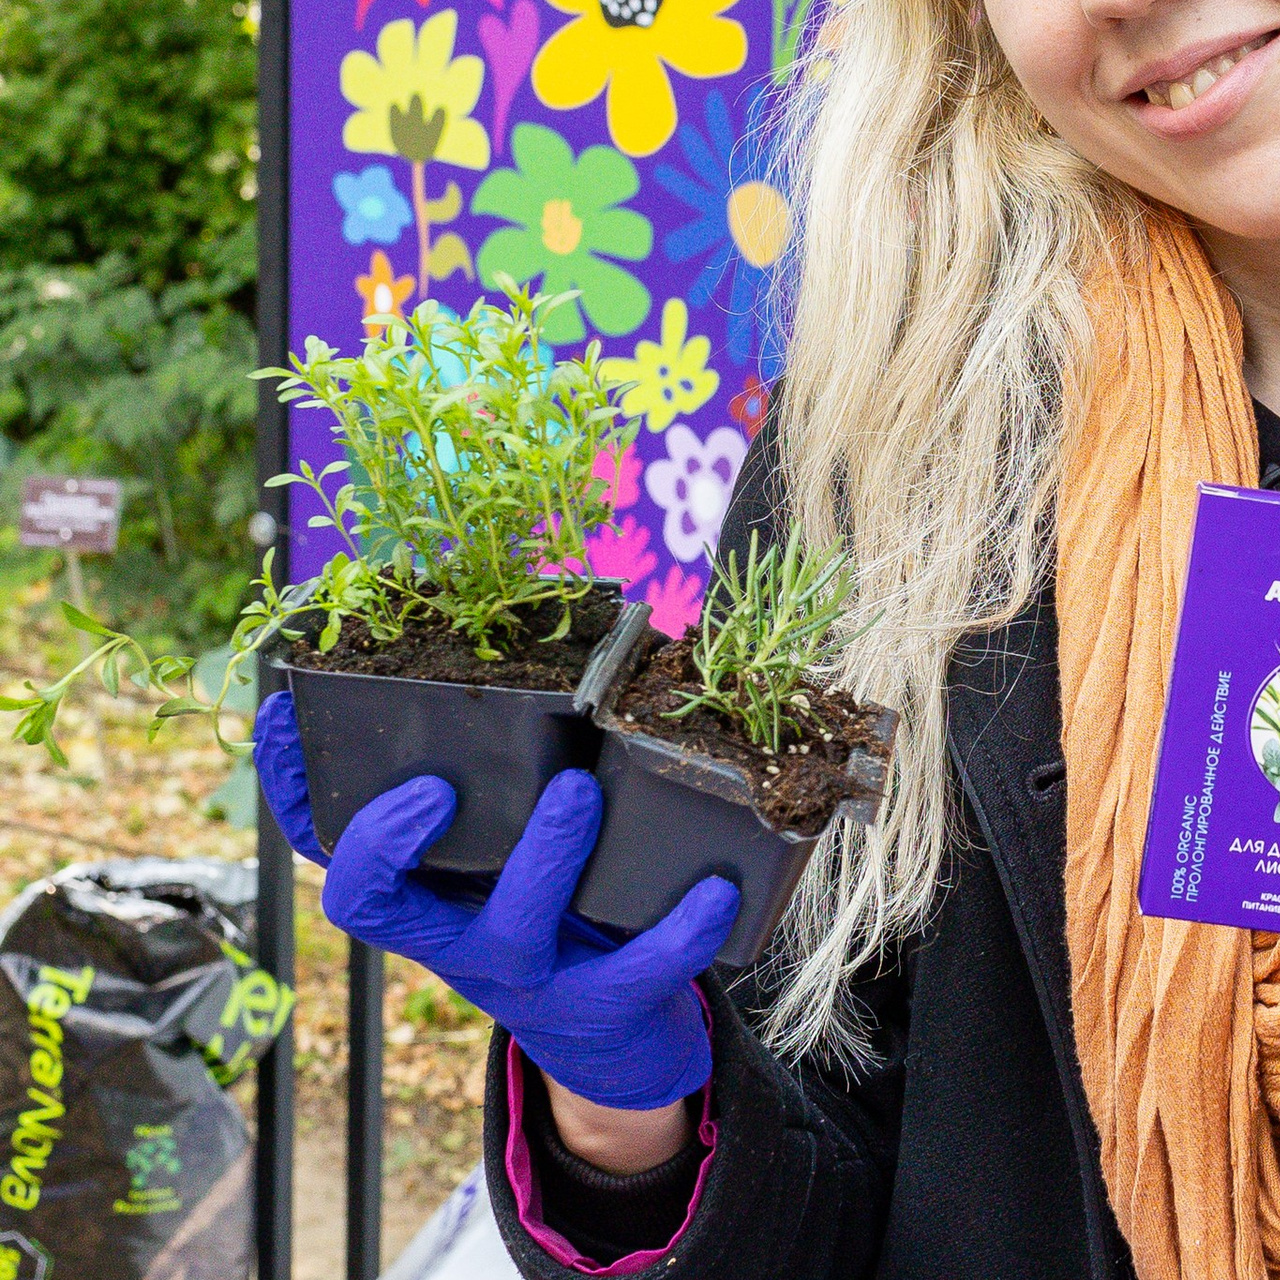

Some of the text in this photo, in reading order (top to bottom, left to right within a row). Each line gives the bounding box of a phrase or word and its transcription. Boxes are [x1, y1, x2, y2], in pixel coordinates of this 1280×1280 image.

[1171, 794, 1197, 899] 100% ORGANIC
[1186, 670, 1231, 902] ПРОЛОНГИРОВАННОЕ ДЕЙСТВИЕ
[1229, 837, 1265, 853] ДЛЯ
[2, 965, 95, 1211] TerraNova
